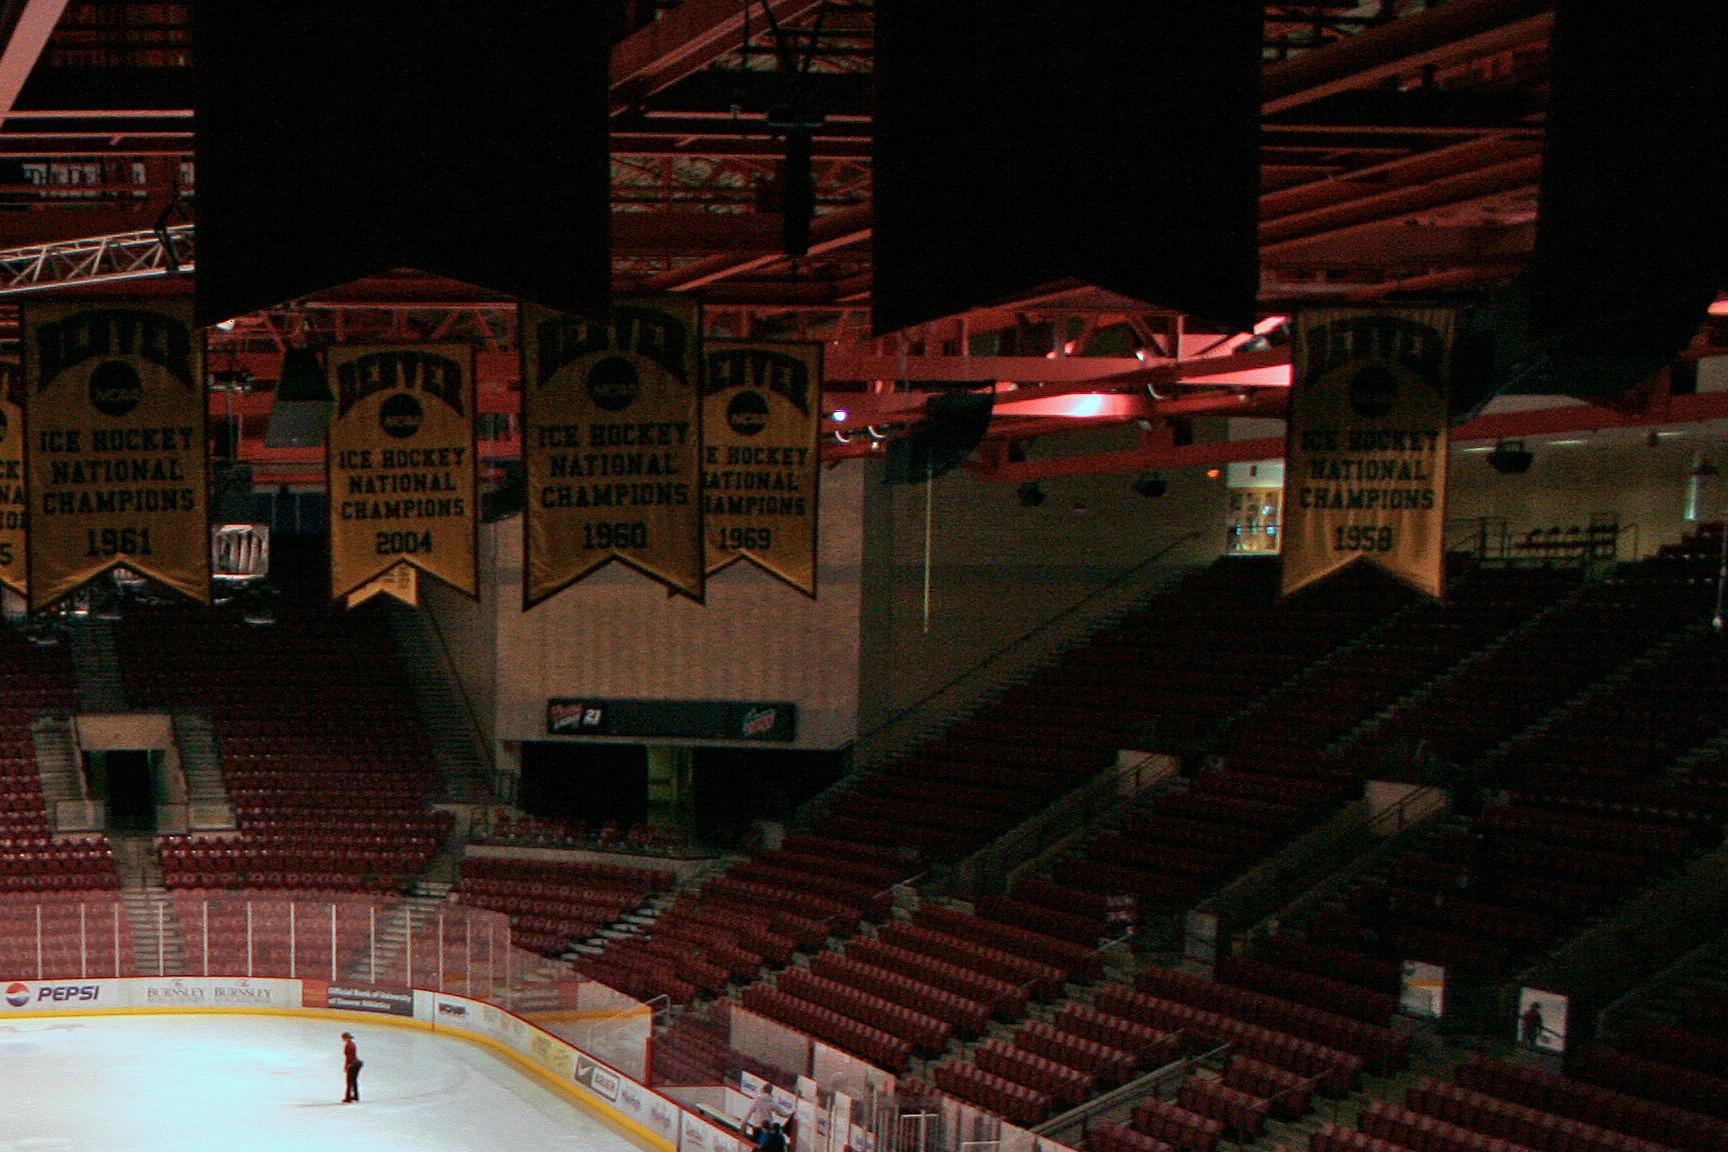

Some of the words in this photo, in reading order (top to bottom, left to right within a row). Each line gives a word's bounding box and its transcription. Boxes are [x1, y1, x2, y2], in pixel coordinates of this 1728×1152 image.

[35, 311, 196, 394] DENVER
[337, 351, 465, 417] DENVER
[40, 430, 81, 452] ICE
[93, 426, 195, 451] HOCKEY
[538, 424, 578, 447] ICE
[591, 421, 690, 445] HOCKEY
[338, 449, 373, 469] ICE
[383, 447, 466, 468] HOCKEY
[551, 452, 679, 476] NATIONAL
[727, 446, 810, 466] HOCKEY
[52, 458, 184, 484] NATIONAL
[1311, 458, 1428, 480] NATIONAL
[350, 472, 456, 494] NATIONAL
[541, 482, 689, 508] CHAMPIONS
[43, 488, 195, 514] CHAMPIONS
[341, 497, 465, 519] CHAMPIONS
[1300, 487, 1435, 510] CHAMPIONS
[87, 526, 152, 556] 1961
[377, 530, 433, 555] 2004
[719, 526, 772, 550] 1969
[1335, 525, 1393, 551] 1958
[37, 986, 100, 1001] PEPSI
